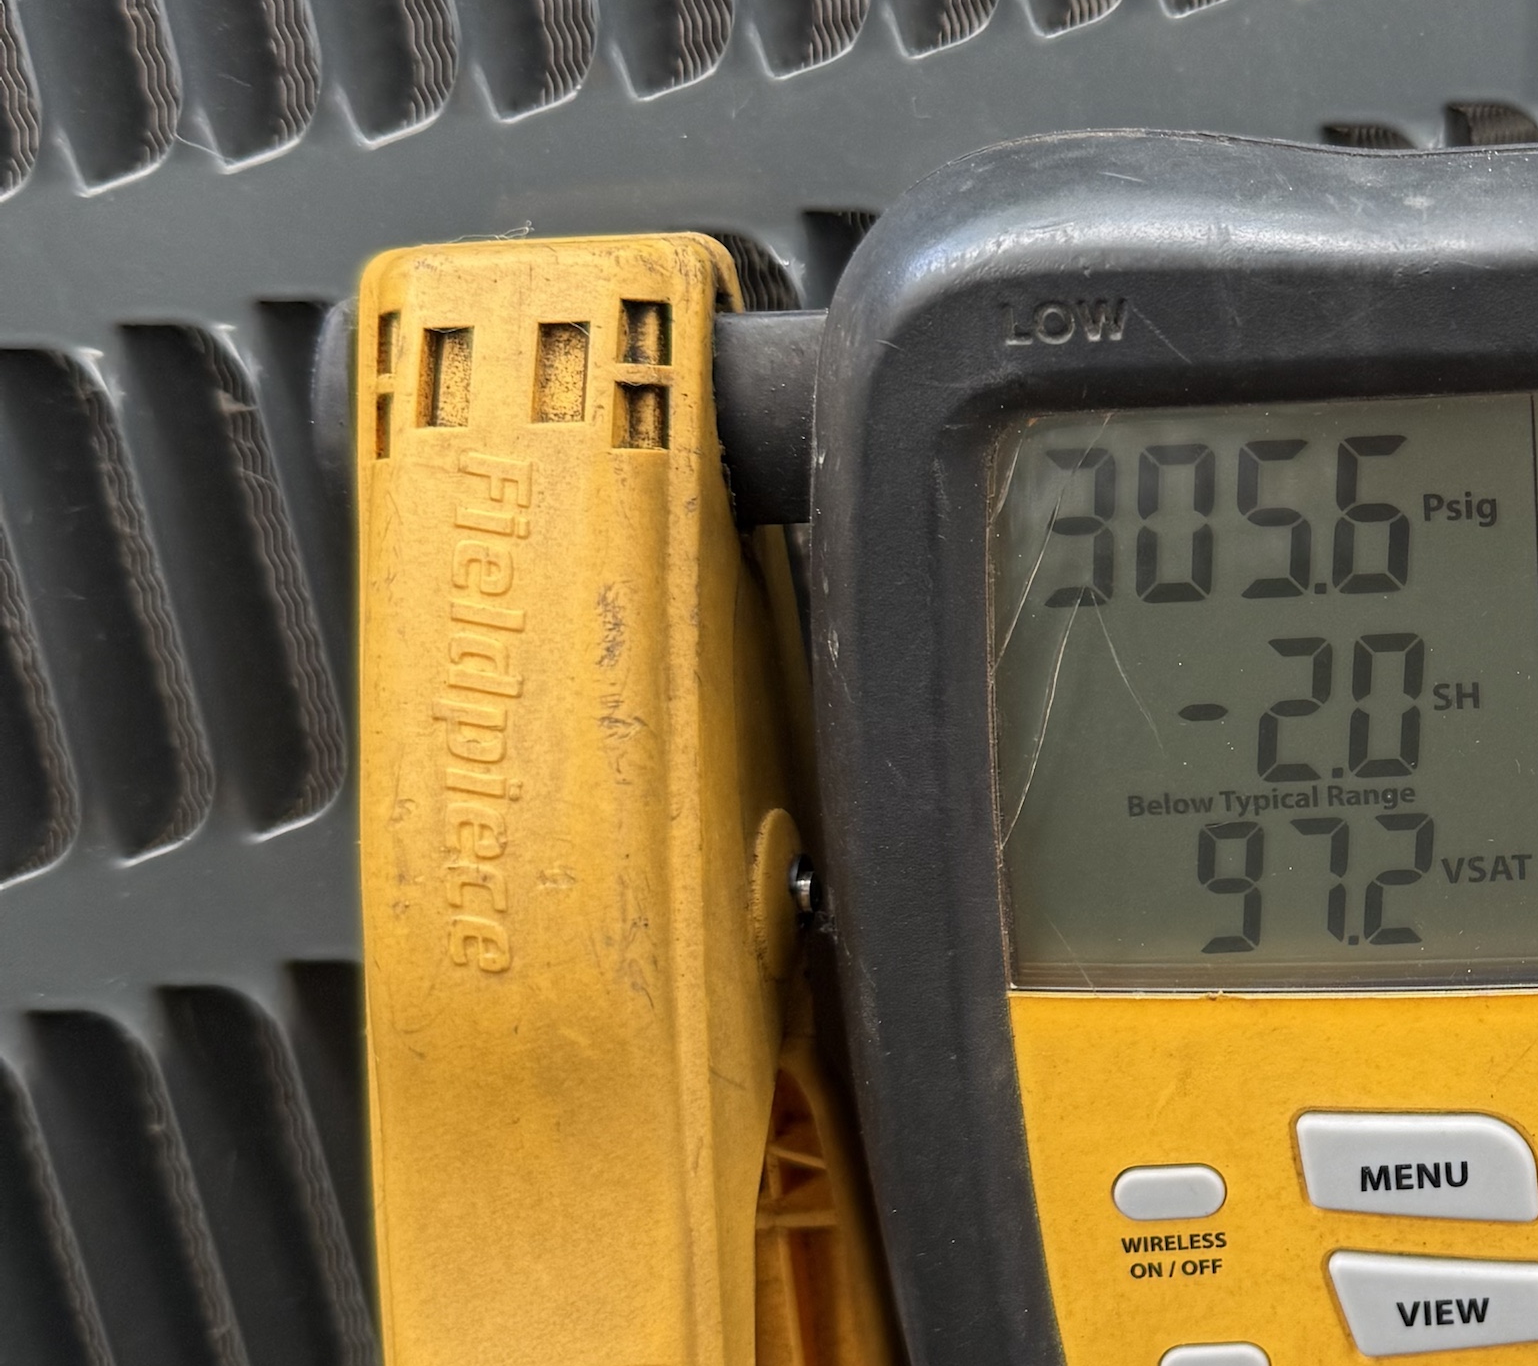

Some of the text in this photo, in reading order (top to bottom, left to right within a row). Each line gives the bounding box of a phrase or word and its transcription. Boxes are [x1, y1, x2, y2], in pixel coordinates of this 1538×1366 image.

[1002, 298, 1128, 344] LOW
[1044, 434, 1498, 607] 305.6 Psig
[433, 451, 532, 973] Fieldpiece
[1177, 633, 1480, 783] -2.0 SH
[1127, 783, 1416, 818] Below Typical Range
[1197, 813, 1532, 954] 97.2 VSAT
[1360, 1160, 1470, 1192] MENU
[1121, 1231, 1227, 1254] WIRELESS
[1130, 1262, 1165, 1279] ON
[1181, 1258, 1224, 1277] OFF
[1396, 1297, 1490, 1328] VIEW
